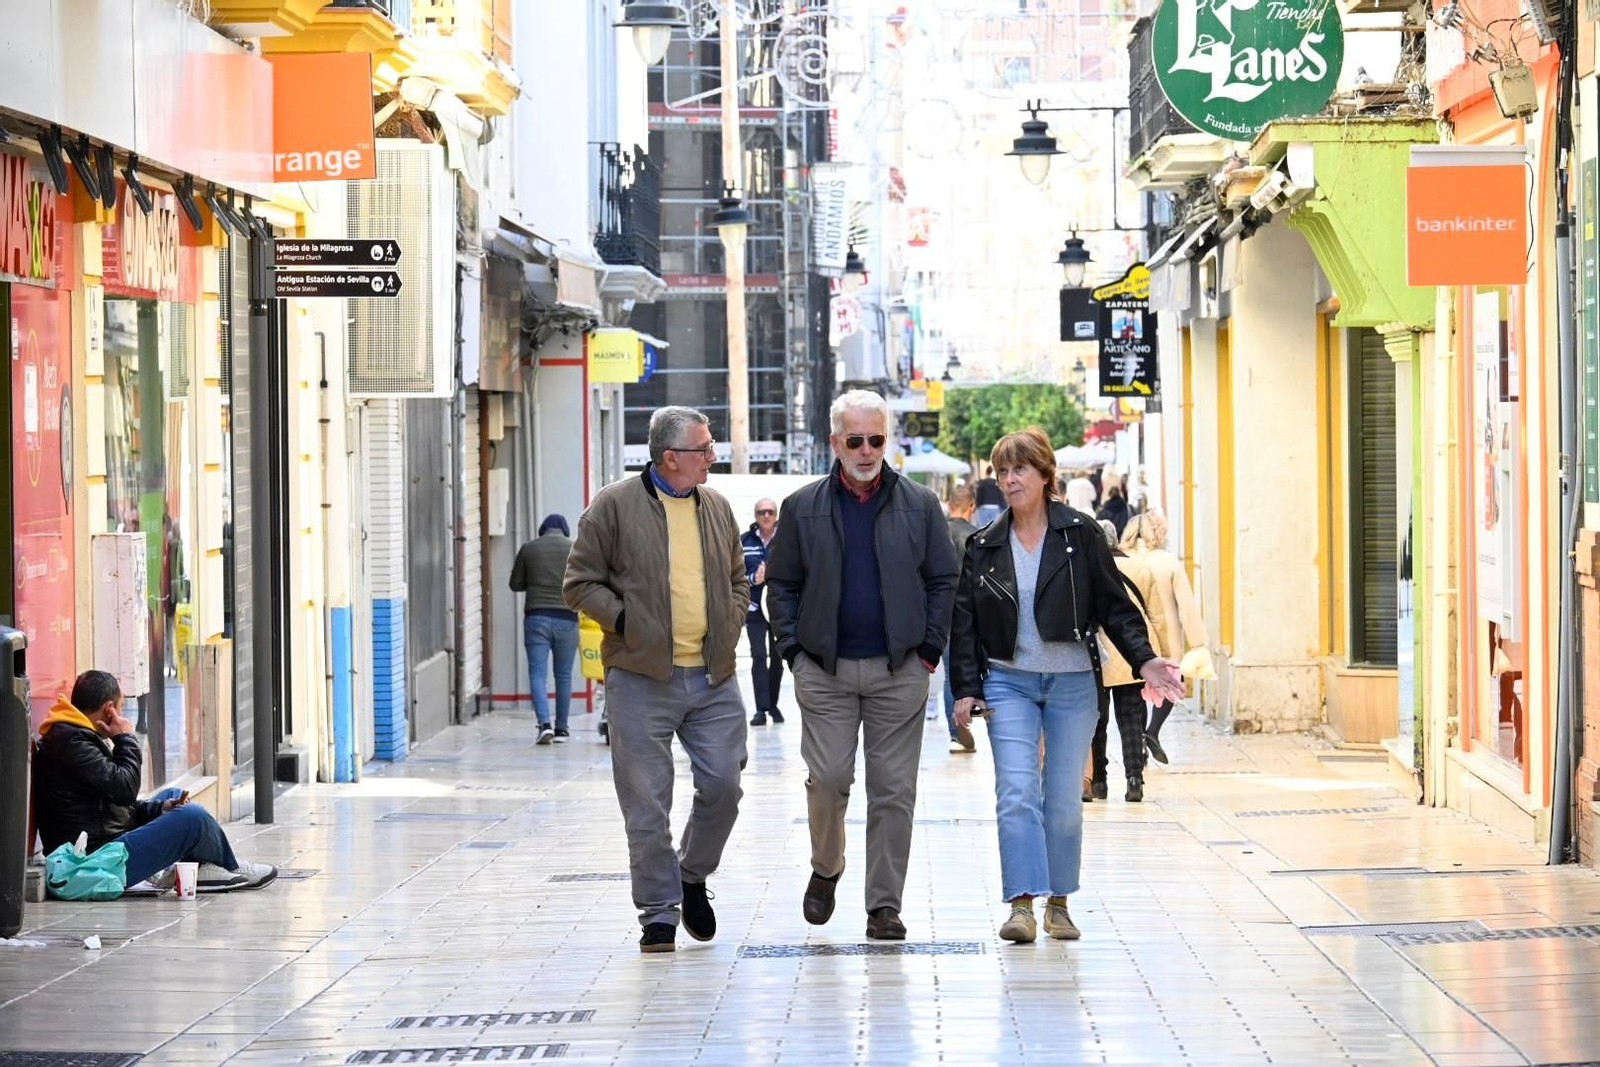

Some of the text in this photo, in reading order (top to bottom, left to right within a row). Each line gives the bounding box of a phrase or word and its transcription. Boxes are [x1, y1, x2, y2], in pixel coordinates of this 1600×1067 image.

[1204, 113, 1251, 133] Fundada
[274, 149, 361, 177] range
[825, 179, 846, 260] ANDAMIOS
[1416, 216, 1516, 232] bankinter
[276, 244, 353, 253] Iglesia de la Milagrosa
[277, 275, 370, 284] Antigua Estación de Sevilla
[1104, 344, 1151, 354] ARTESANO
